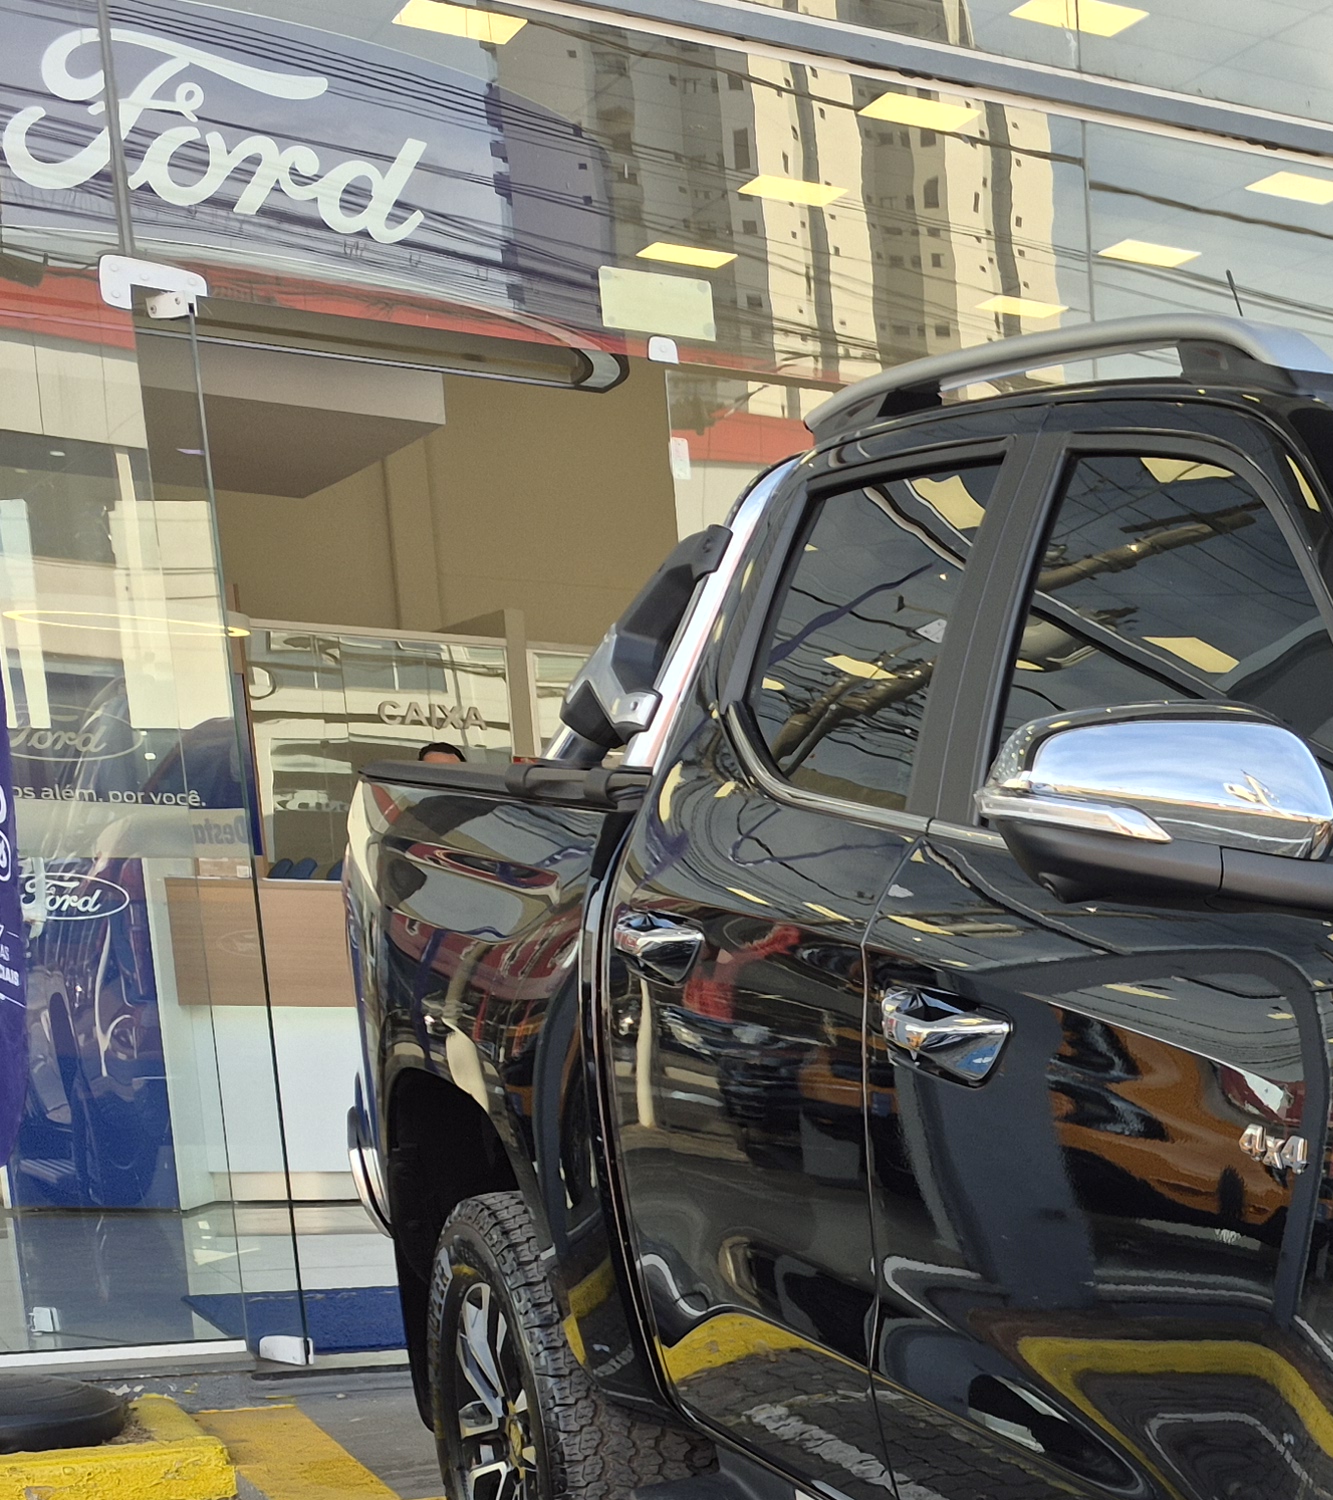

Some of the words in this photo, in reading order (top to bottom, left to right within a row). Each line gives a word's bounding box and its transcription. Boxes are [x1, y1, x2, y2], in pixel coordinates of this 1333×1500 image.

[2, 28, 427, 243] Ford
[377, 700, 488, 731] CAIXA
[149, 789, 207, 807] você.
[1239, 1123, 1308, 1175] 4x4
